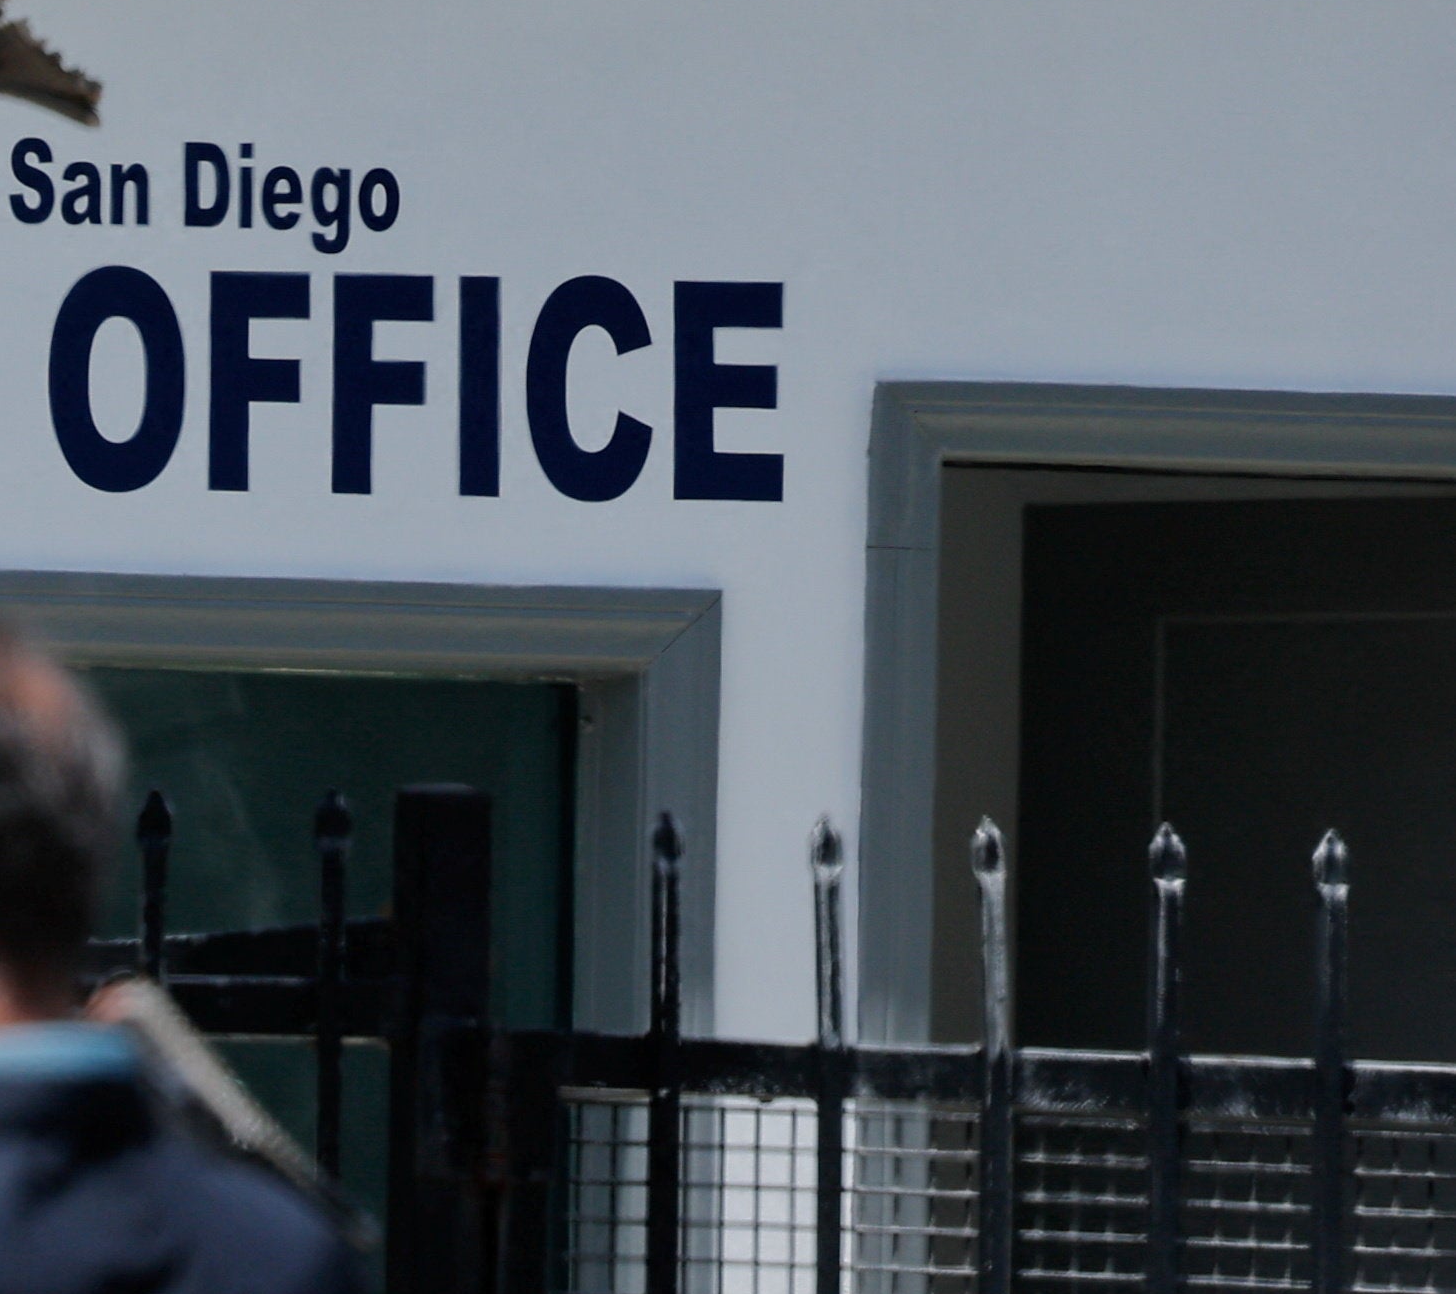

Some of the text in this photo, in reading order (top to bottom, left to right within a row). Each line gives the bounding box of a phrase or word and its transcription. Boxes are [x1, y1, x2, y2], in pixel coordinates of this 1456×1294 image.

[9, 137, 150, 226] San
[184, 141, 401, 255] Diego
[47, 265, 785, 502] OFFICE
